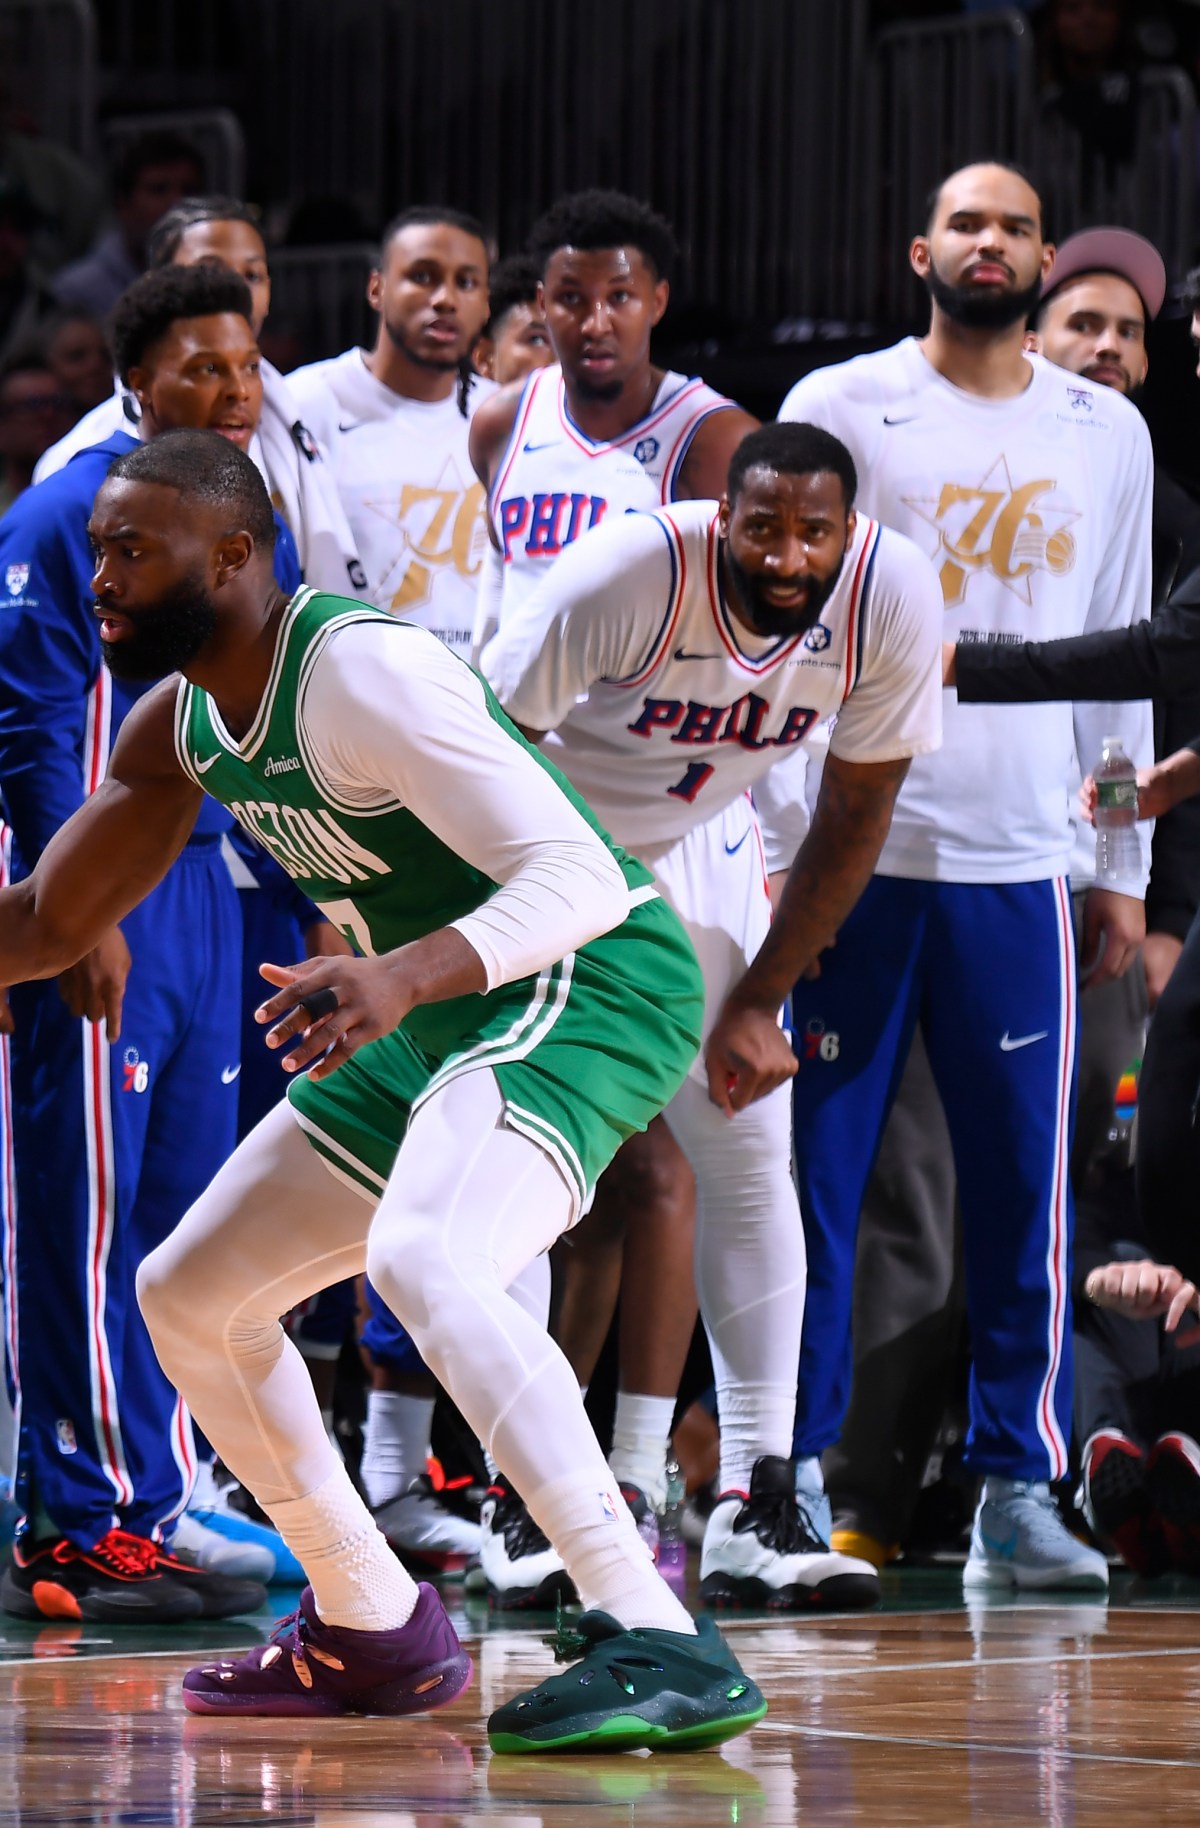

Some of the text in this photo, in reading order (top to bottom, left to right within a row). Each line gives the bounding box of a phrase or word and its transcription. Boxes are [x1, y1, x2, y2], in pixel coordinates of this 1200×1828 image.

[264, 755, 301, 777] Amica
[666, 762, 716, 805] 1
[804, 1031, 840, 1062] 76
[123, 1061, 149, 1093] 76
